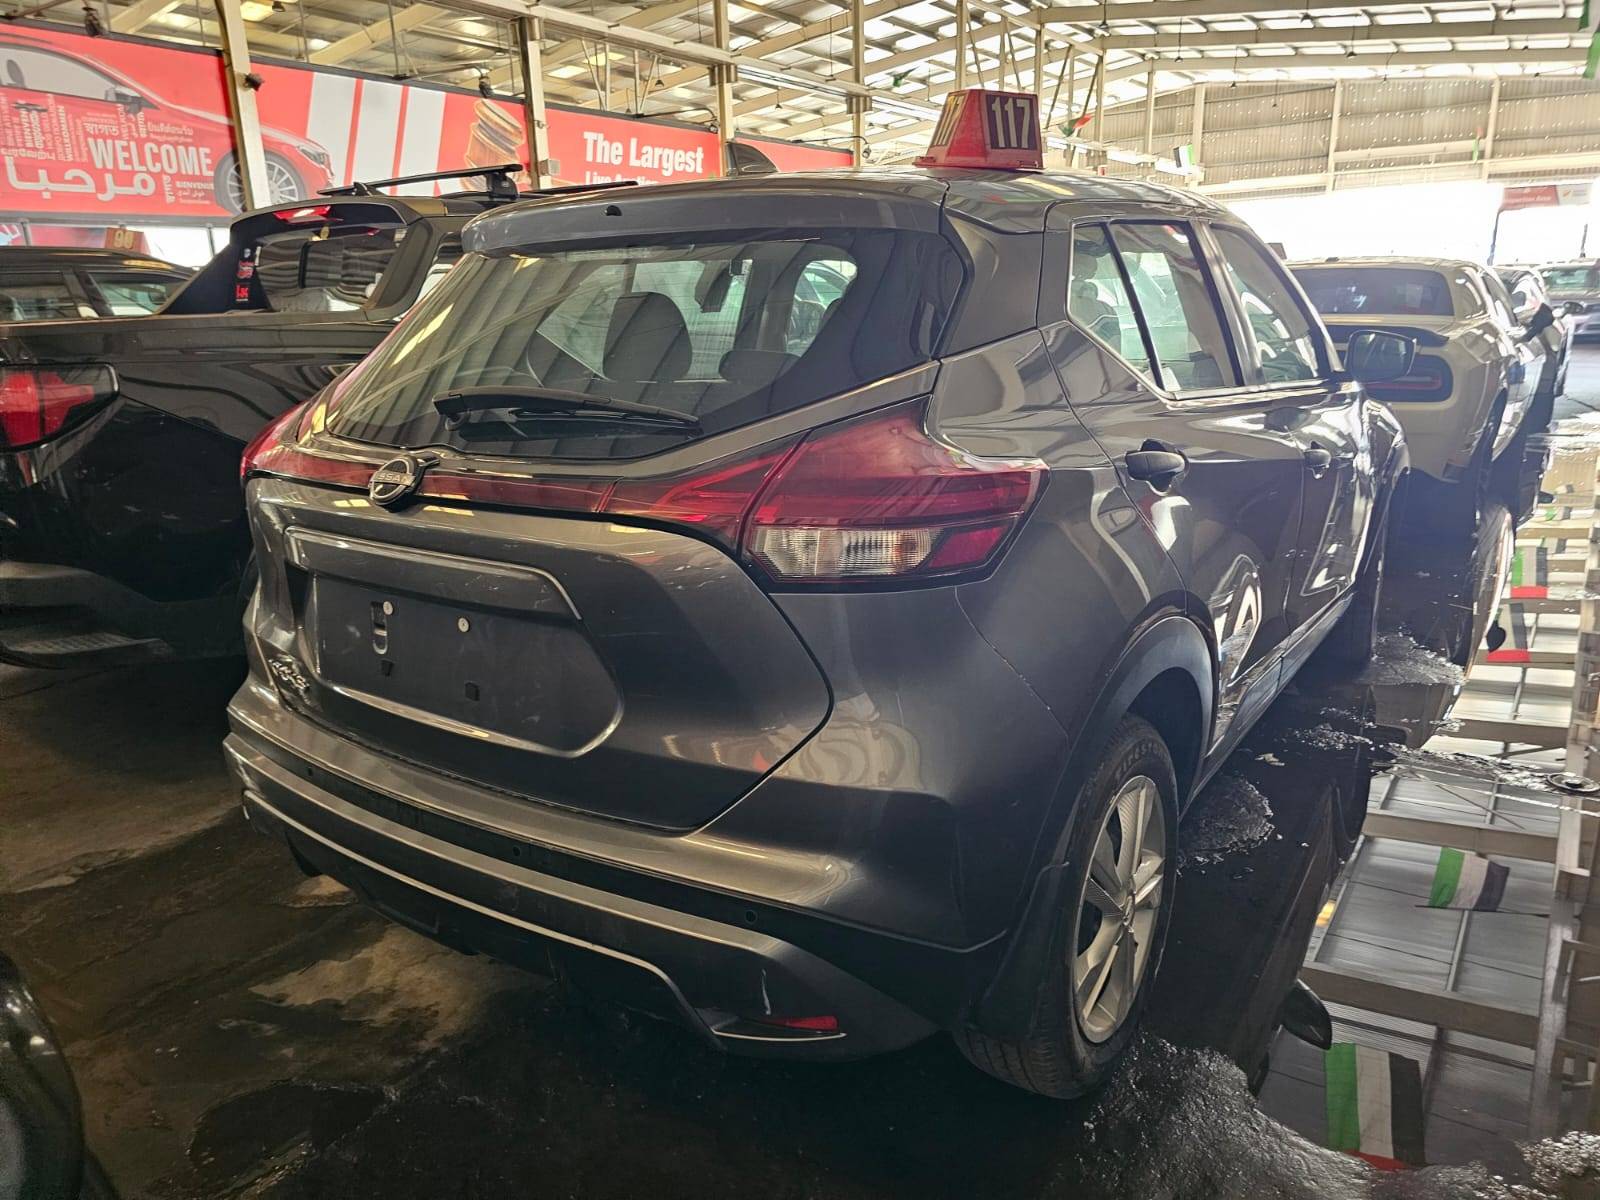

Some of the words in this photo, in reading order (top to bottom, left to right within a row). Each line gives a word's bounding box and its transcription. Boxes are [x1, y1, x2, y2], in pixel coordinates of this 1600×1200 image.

[991, 96, 1031, 149] 117
[87, 137, 214, 177] WELCOME
[583, 131, 624, 166] The
[629, 137, 704, 177] Largest
[4, 155, 156, 202] مرحبا
